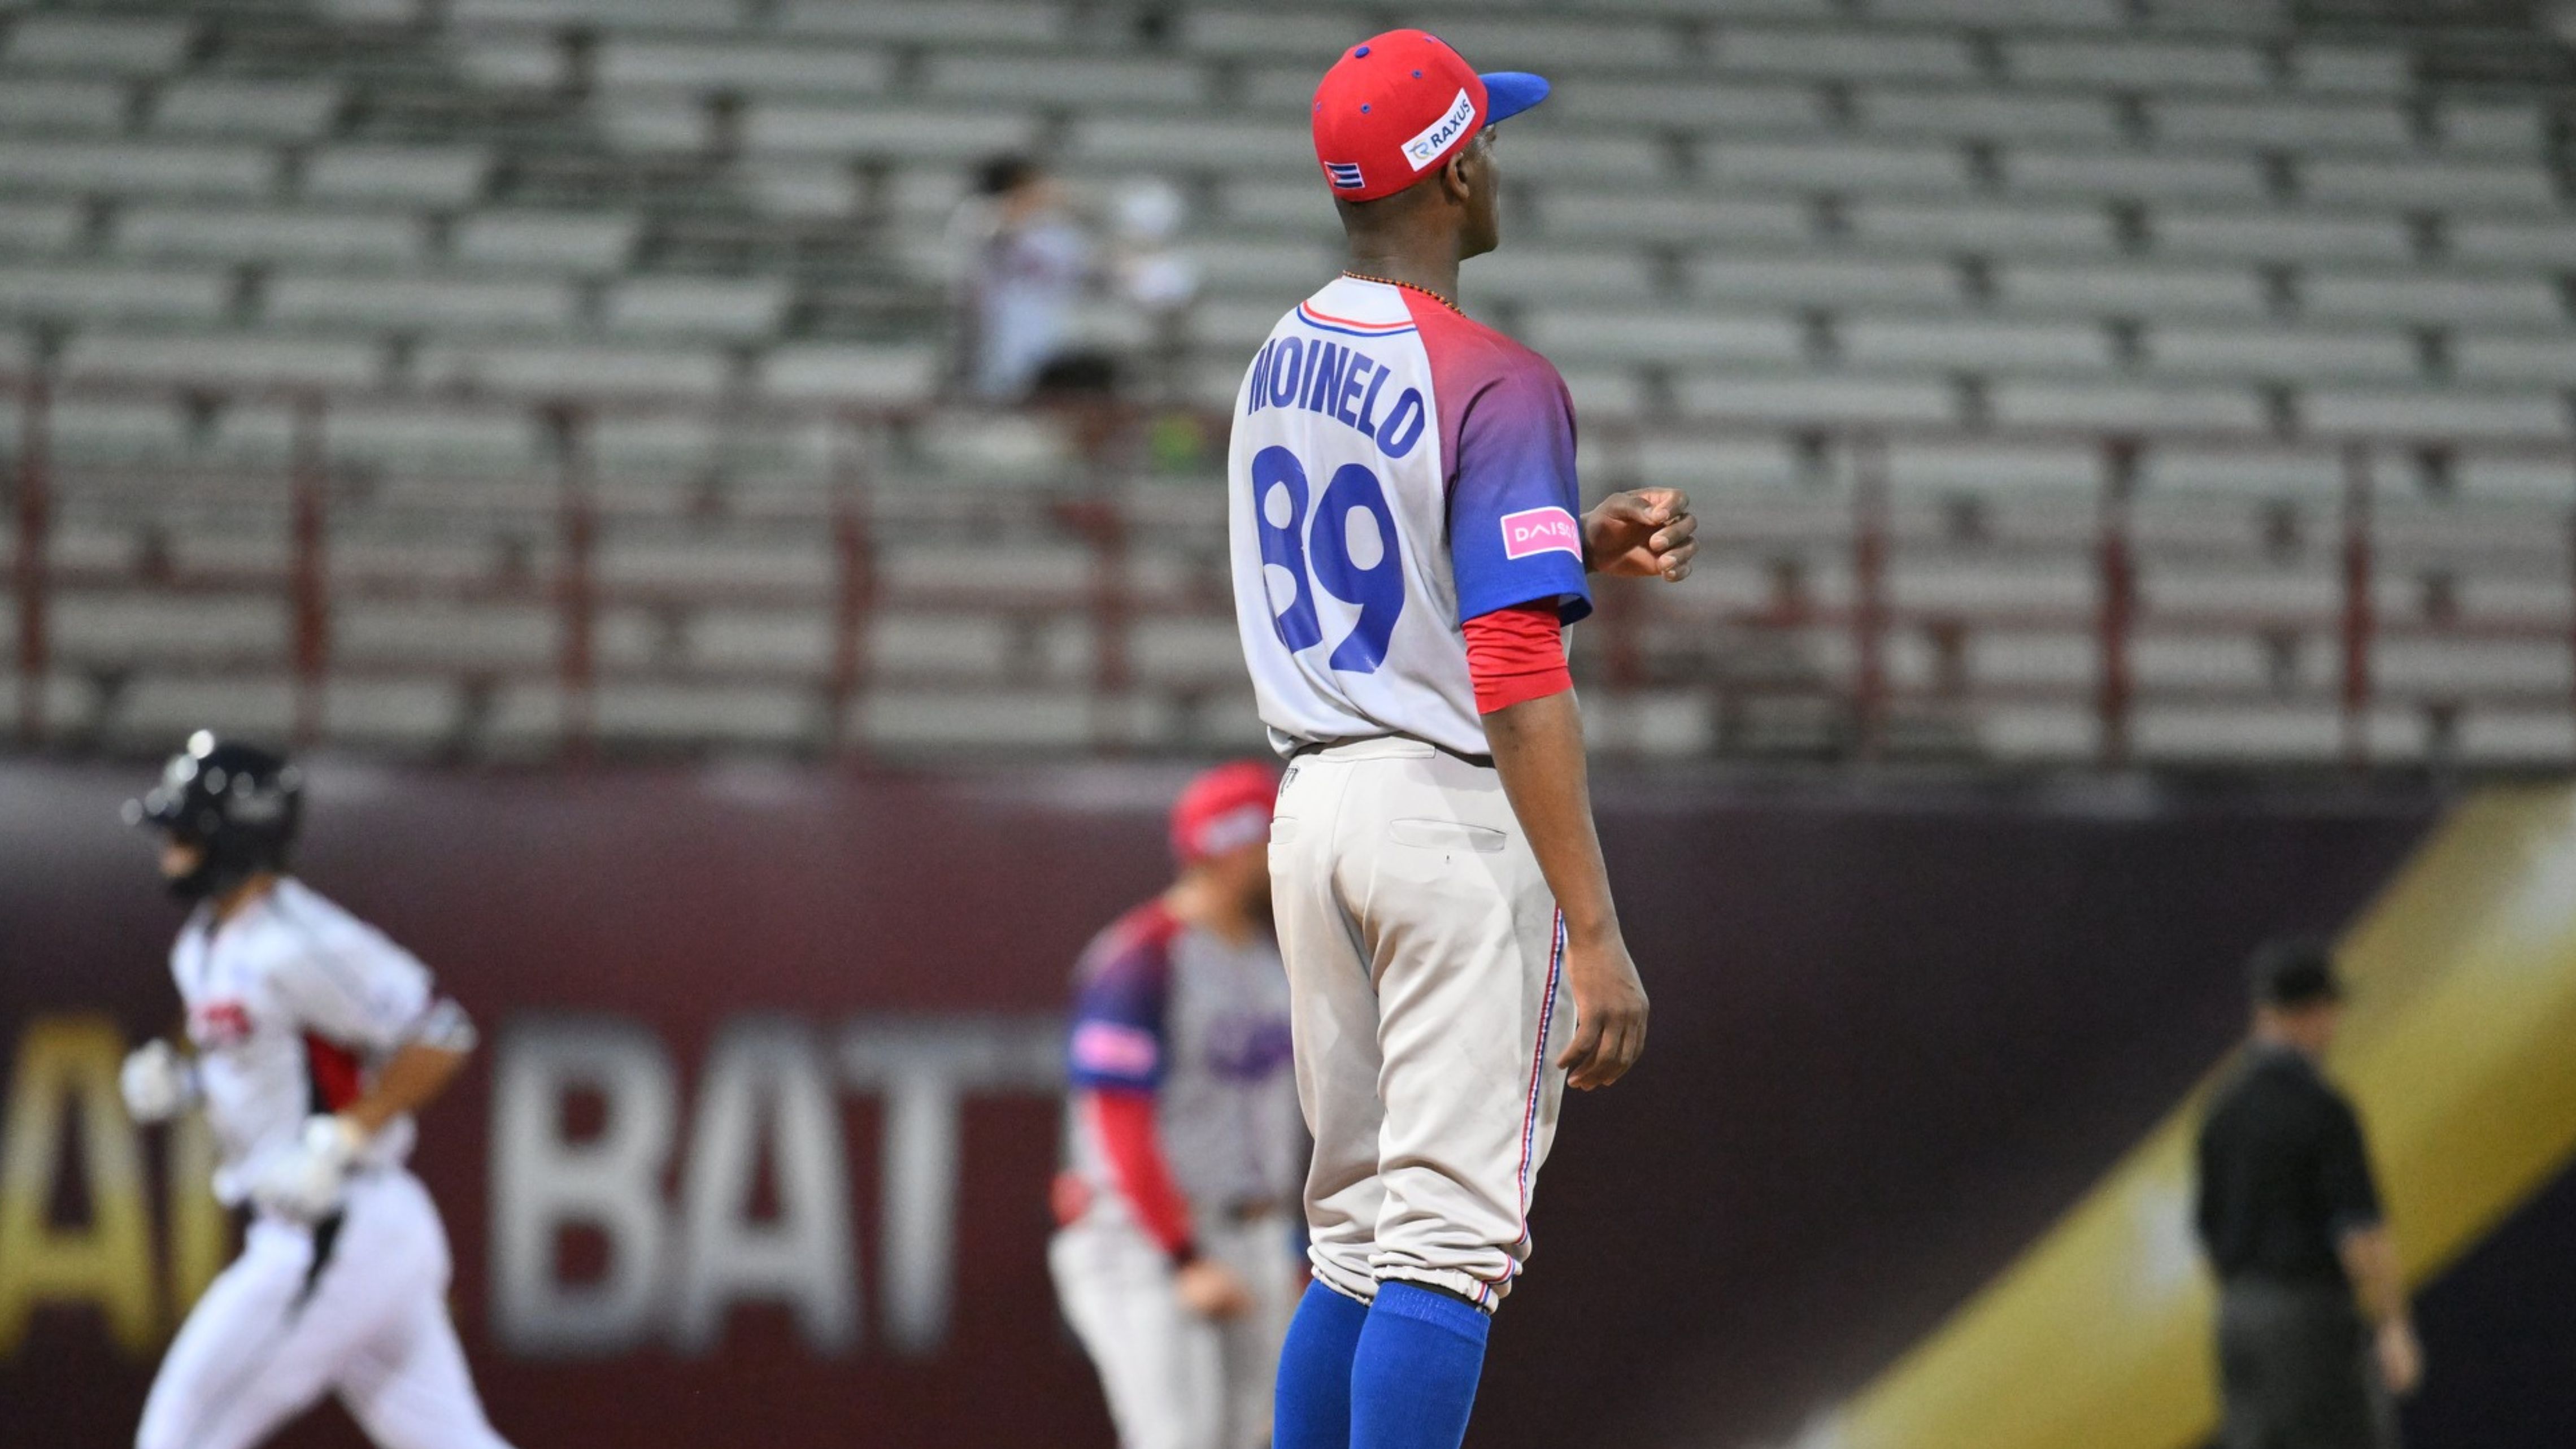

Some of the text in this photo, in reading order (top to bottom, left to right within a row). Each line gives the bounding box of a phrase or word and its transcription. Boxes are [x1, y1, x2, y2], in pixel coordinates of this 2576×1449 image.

[1430, 99, 1470, 148] RAXUS
[1248, 337, 1424, 458] MOINELO
[1251, 445, 1405, 675] 89
